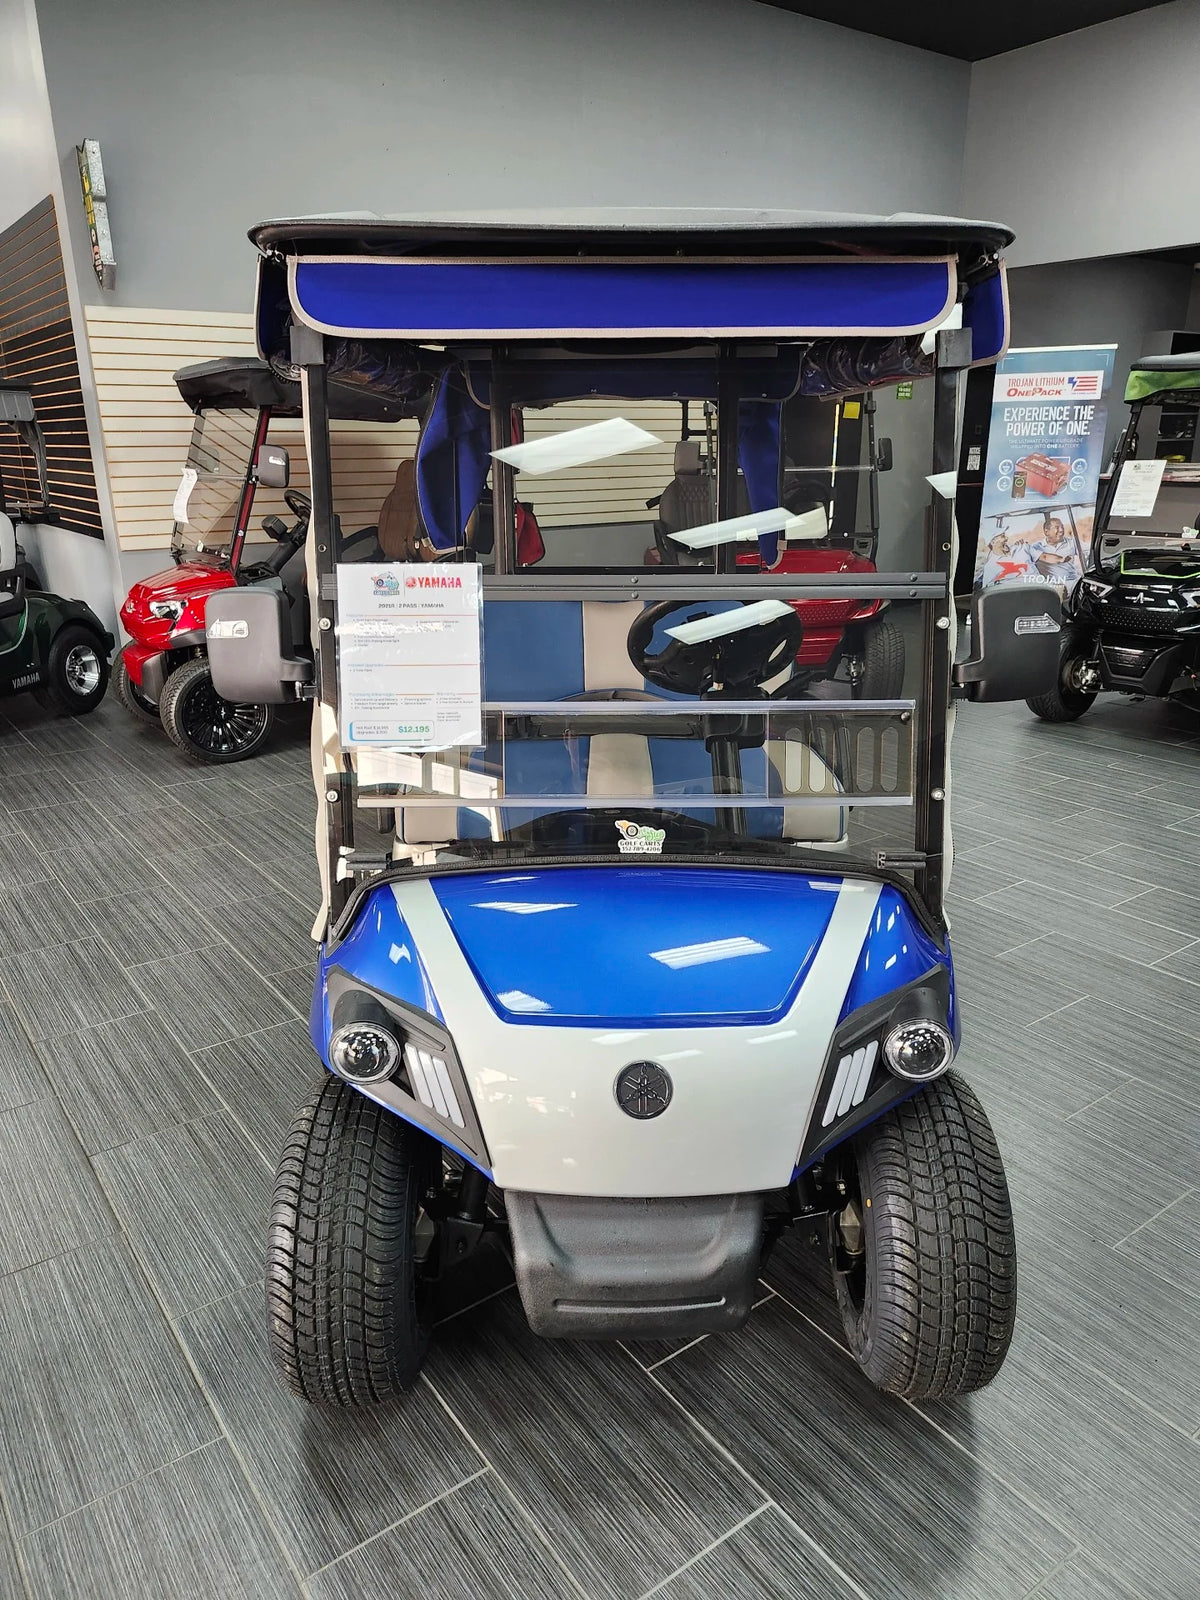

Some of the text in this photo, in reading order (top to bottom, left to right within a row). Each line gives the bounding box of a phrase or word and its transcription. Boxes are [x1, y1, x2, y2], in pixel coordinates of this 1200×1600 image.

[1008, 377, 1065, 387] TROJAN LITHIUM
[1003, 405, 1095, 421] EXPERIENCE THE
[1006, 421, 1091, 437] POWER OF ONE.
[418, 577, 462, 588] YAMAHA
[1022, 574, 1067, 585] TROJAN
[12, 672, 40, 689] YAMAHA
